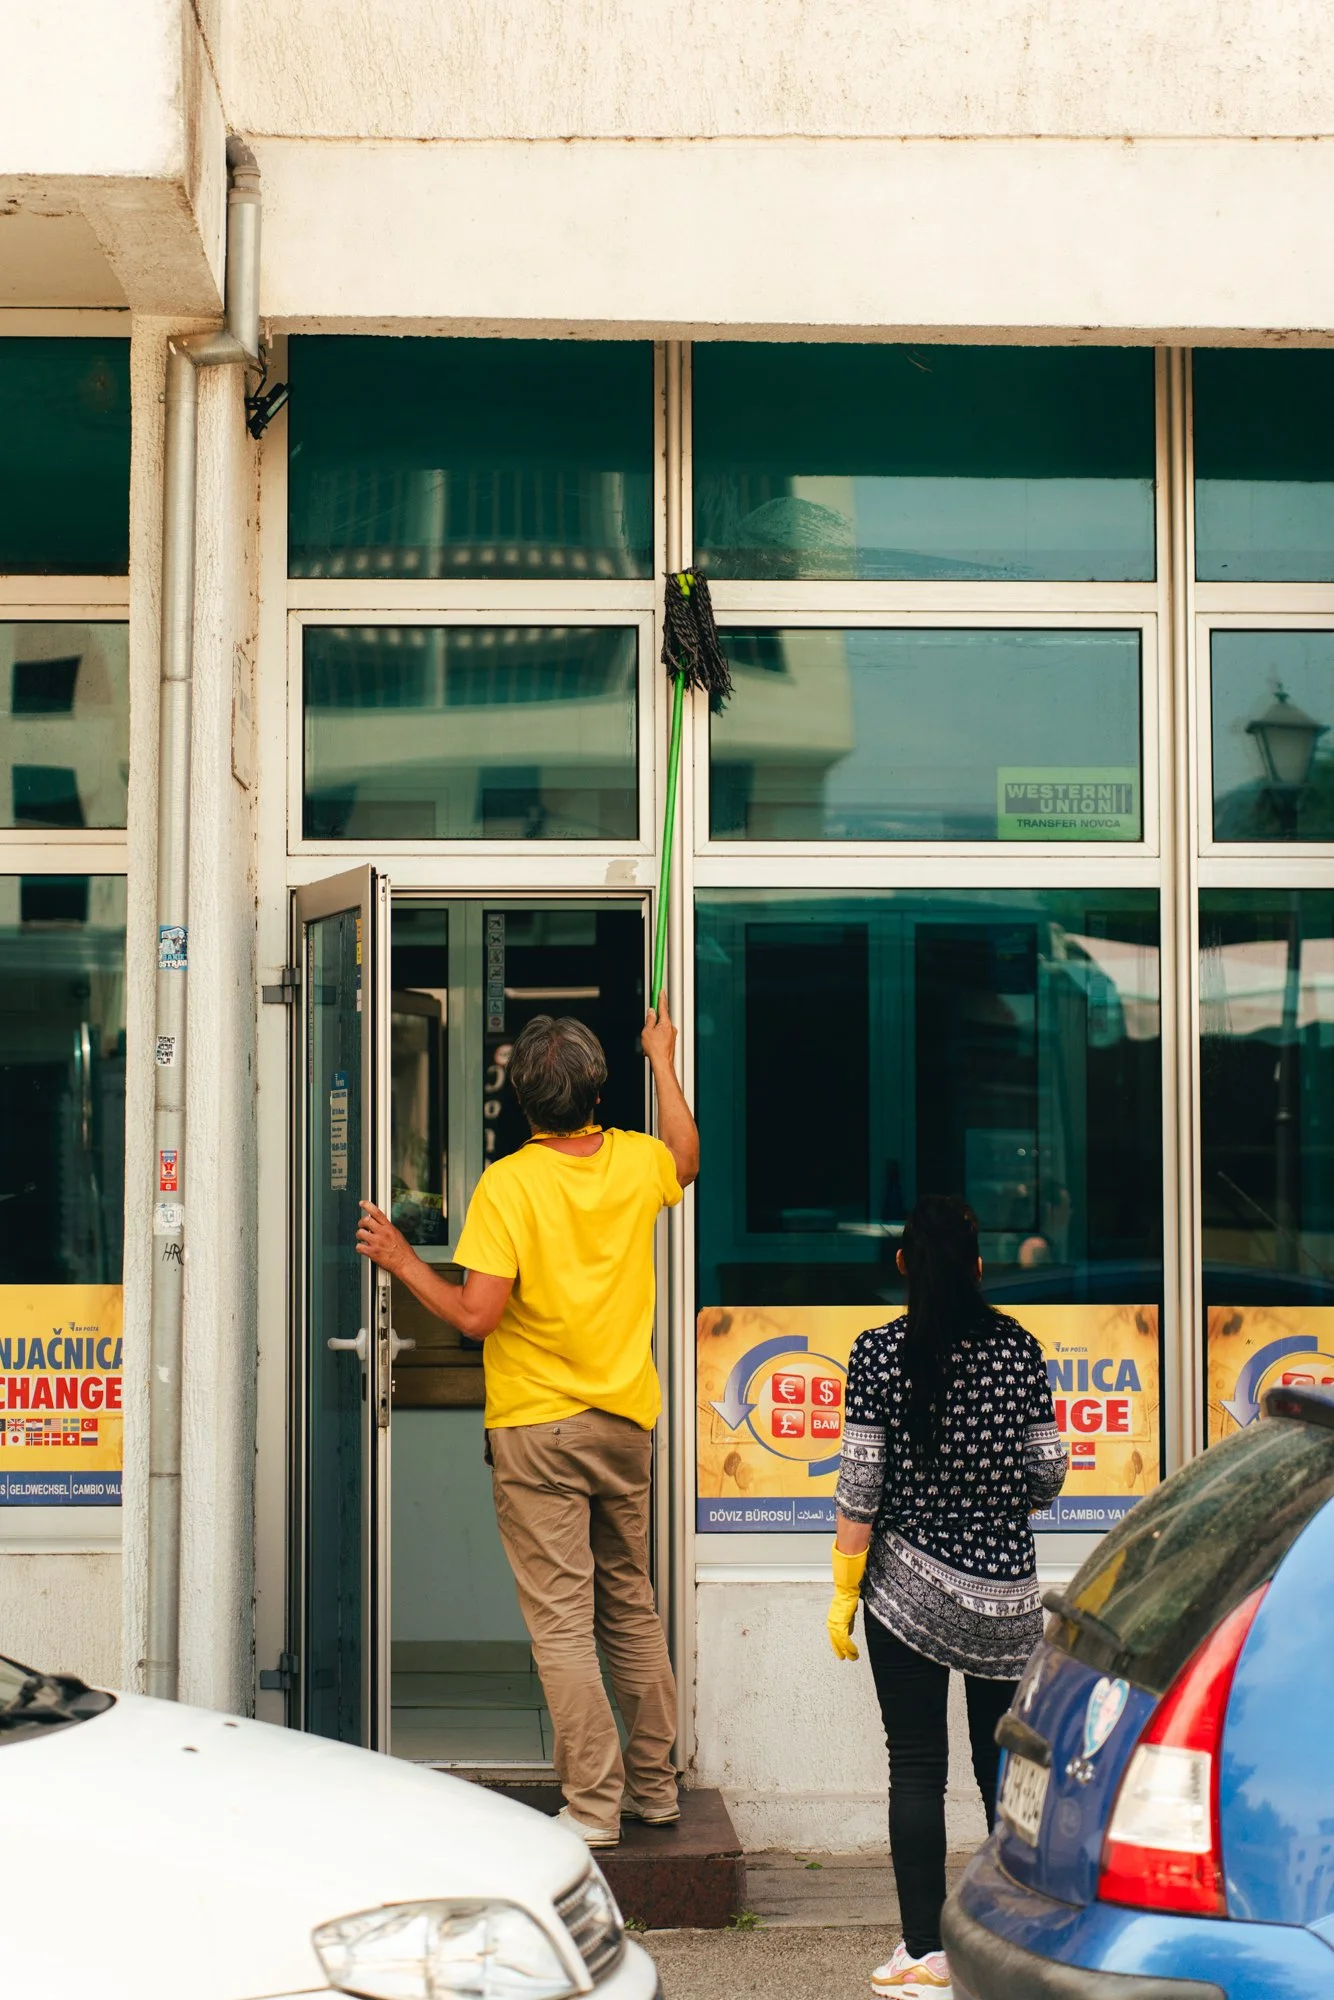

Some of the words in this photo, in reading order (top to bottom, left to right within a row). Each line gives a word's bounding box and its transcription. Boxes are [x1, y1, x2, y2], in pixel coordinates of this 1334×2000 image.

[1006, 784, 1112, 799] WESTERN
[1039, 799, 1112, 813] UNION
[1016, 818, 1077, 829] TRANSFER
[1080, 818, 1121, 829] NOVCA
[0, 1377, 122, 1410] HANGE
[813, 1420, 839, 1430] BAM
[9, 1484, 69, 1495] GELDWECHSEL
[72, 1484, 105, 1495] CAMBIO
[105, 1484, 123, 1495] VAL
[709, 1509, 742, 1522] DÖVIZ
[745, 1509, 792, 1522] BÜROSU
[1061, 1509, 1105, 1520] CAMBIO
